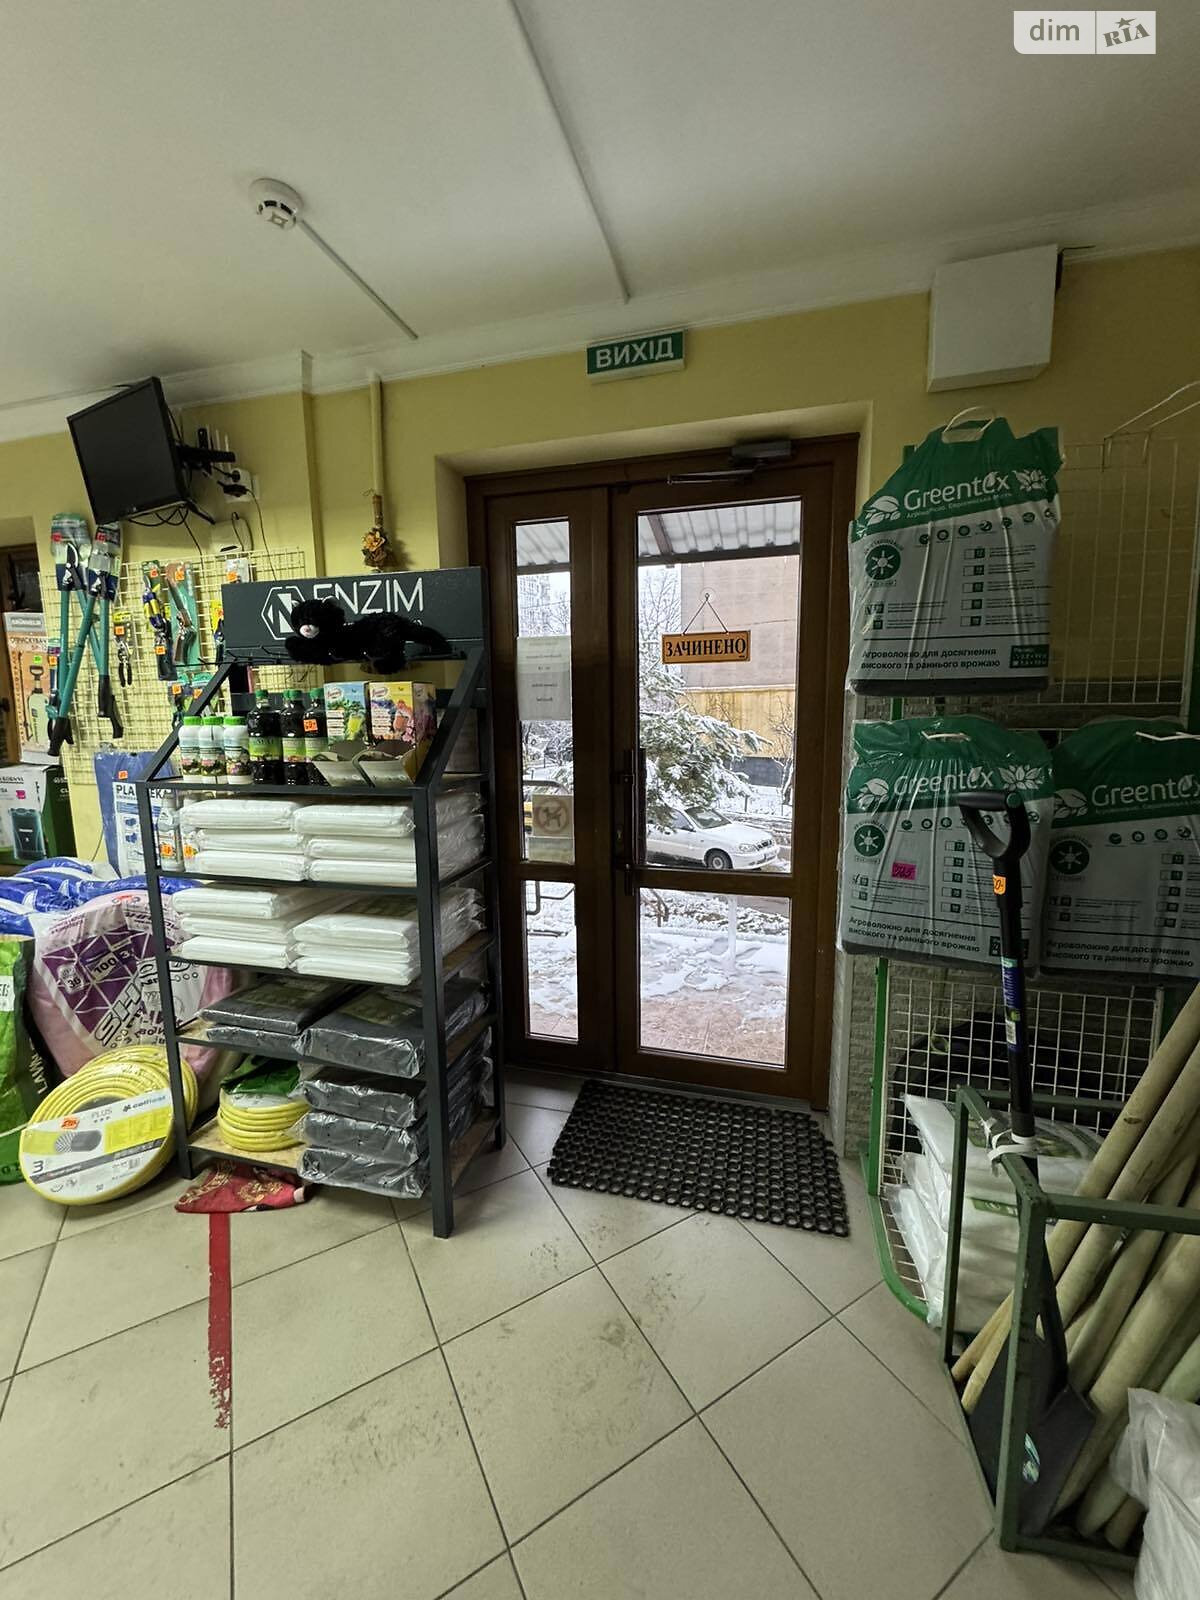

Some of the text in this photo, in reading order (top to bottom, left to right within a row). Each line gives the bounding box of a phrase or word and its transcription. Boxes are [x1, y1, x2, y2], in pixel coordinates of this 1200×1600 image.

[596, 337, 674, 369] ВИХІД
[903, 471, 1010, 511] Greentex
[665, 638, 746, 657] ЗАЧИНЕНО
[922, 649, 938, 661] для
[940, 649, 996, 659] досягнення
[861, 660, 1000, 671] високого та раннього врожаю
[894, 771, 993, 796] Greentex
[848, 928, 884, 939] високого
[889, 935, 898, 943] та
[941, 942, 980, 953] врожаю
[849, 918, 976, 943] Агроволокно для досягнення
[94, 957, 117, 975] 100
